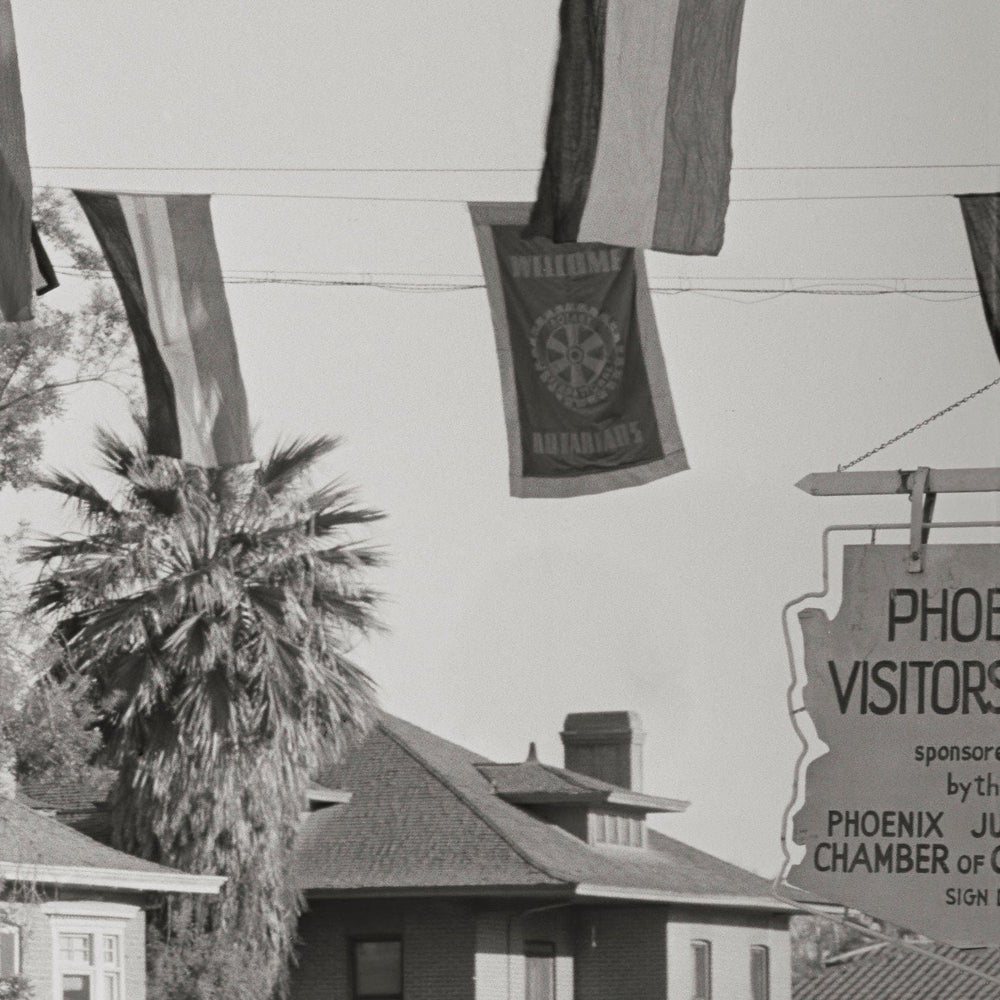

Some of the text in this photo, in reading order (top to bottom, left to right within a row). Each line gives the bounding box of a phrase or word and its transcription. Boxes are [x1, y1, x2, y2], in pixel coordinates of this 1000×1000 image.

[509, 248, 622, 278] WELCOME
[532, 421, 644, 456] ROTARIANS
[888, 587, 1000, 643] PHOE
[827, 659, 1000, 715] VISITORS
[947, 771, 999, 803] by th
[827, 810, 1000, 839] PHOENIX JU
[813, 842, 950, 874] CHAMBER
[957, 854, 985, 875] OF
[945, 888, 988, 906] SIGN
